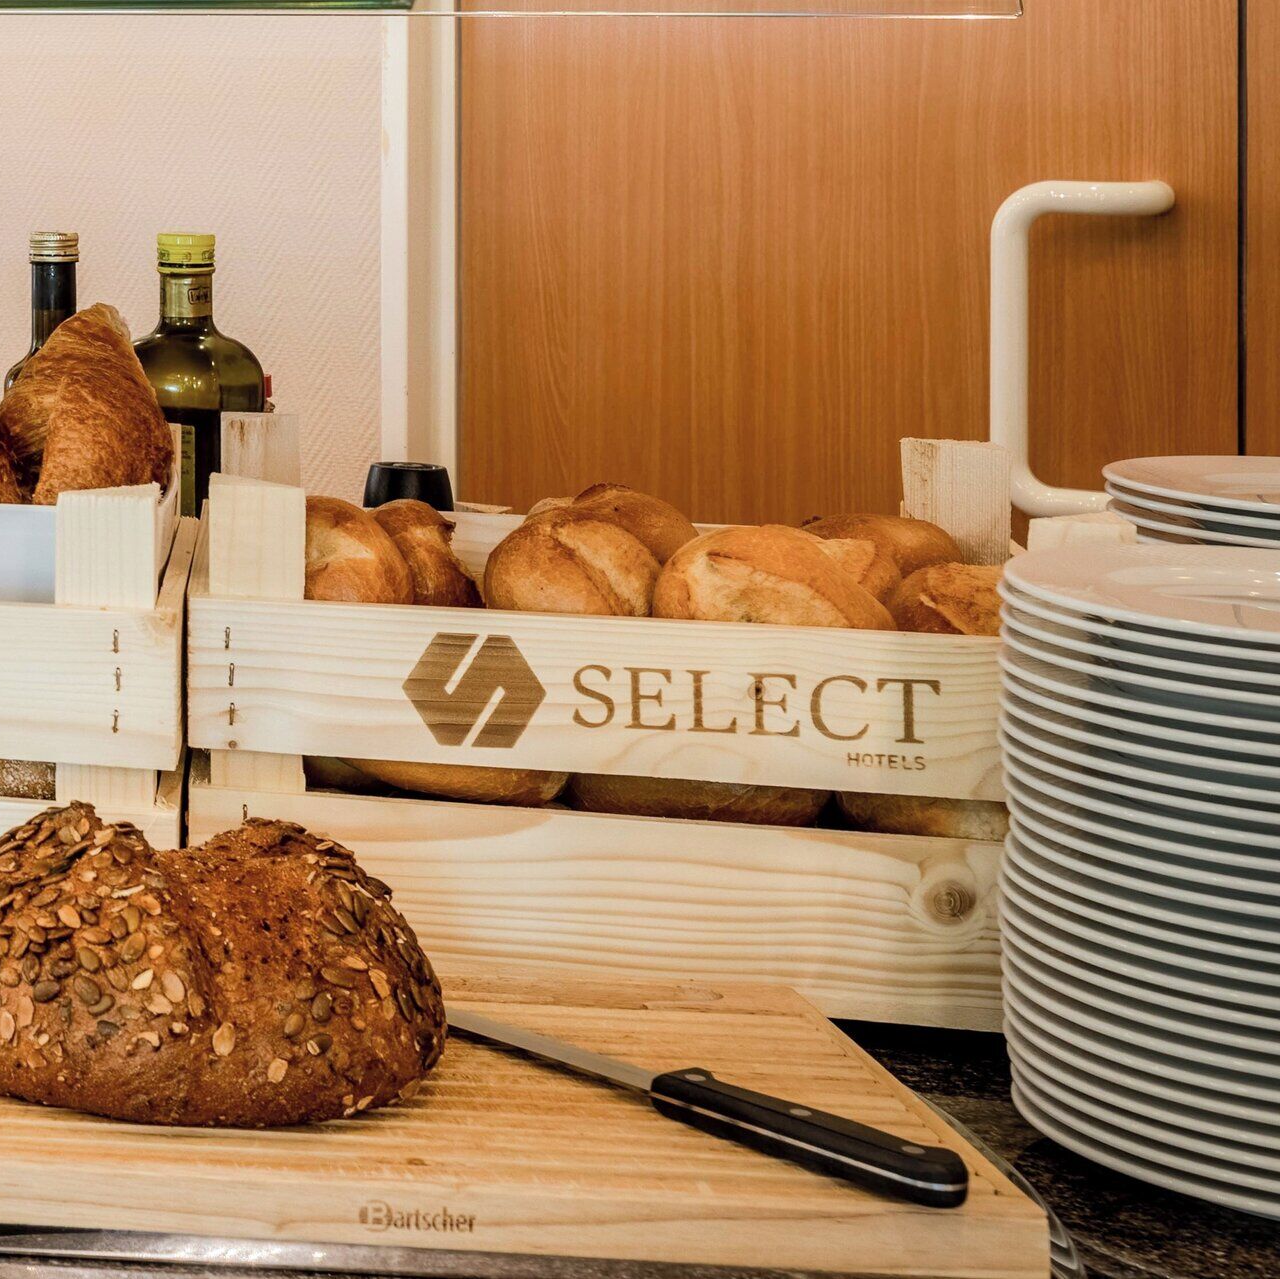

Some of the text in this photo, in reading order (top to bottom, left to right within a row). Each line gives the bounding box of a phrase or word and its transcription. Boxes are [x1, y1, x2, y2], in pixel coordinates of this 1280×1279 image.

[572, 663, 942, 745] SELECT
[846, 751, 927, 771] HOTELS
[358, 1199, 477, 1233] Bartscher
